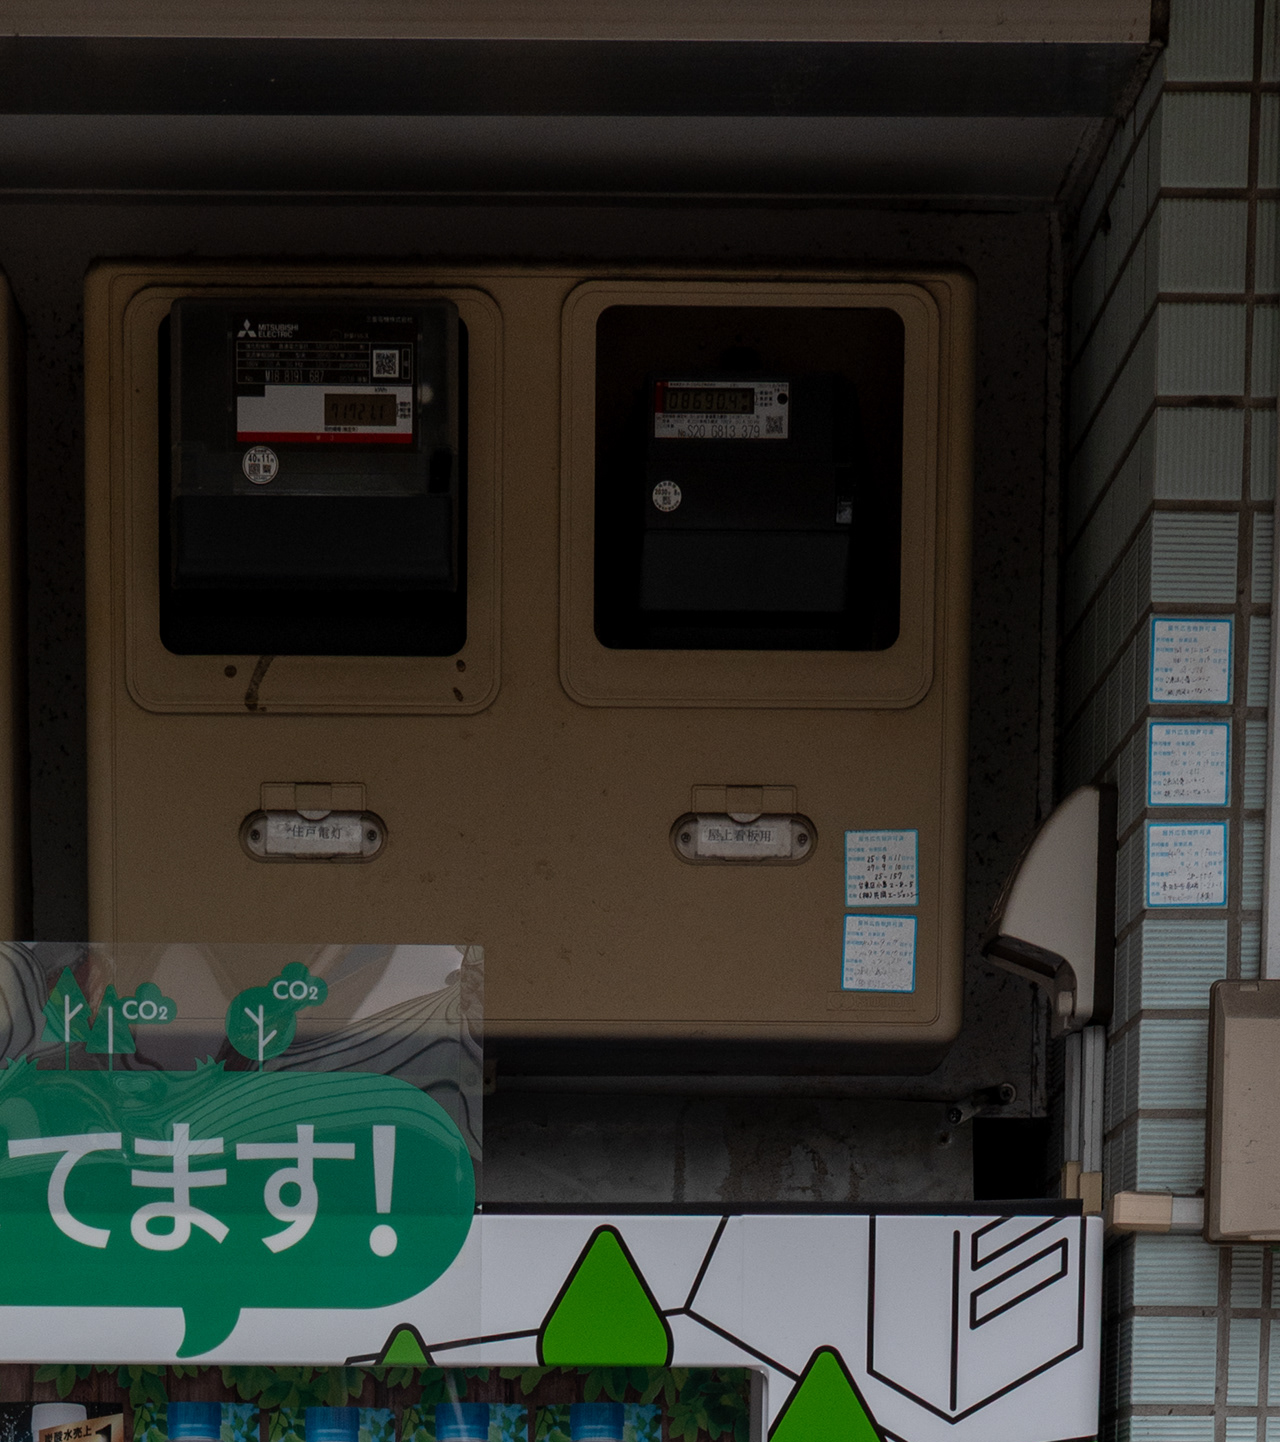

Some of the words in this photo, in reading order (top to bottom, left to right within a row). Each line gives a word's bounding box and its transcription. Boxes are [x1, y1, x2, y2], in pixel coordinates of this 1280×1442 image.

[258, 323, 299, 331] MITSUBISHI
[258, 331, 293, 339] ELECTRIC
[284, 370, 303, 382] 8191
[309, 370, 324, 382] 687
[687, 424, 706, 438] S20
[741, 425, 761, 438] 379
[707, 828, 772, 843] 屋上看板用
[272, 980, 320, 1001] CO2
